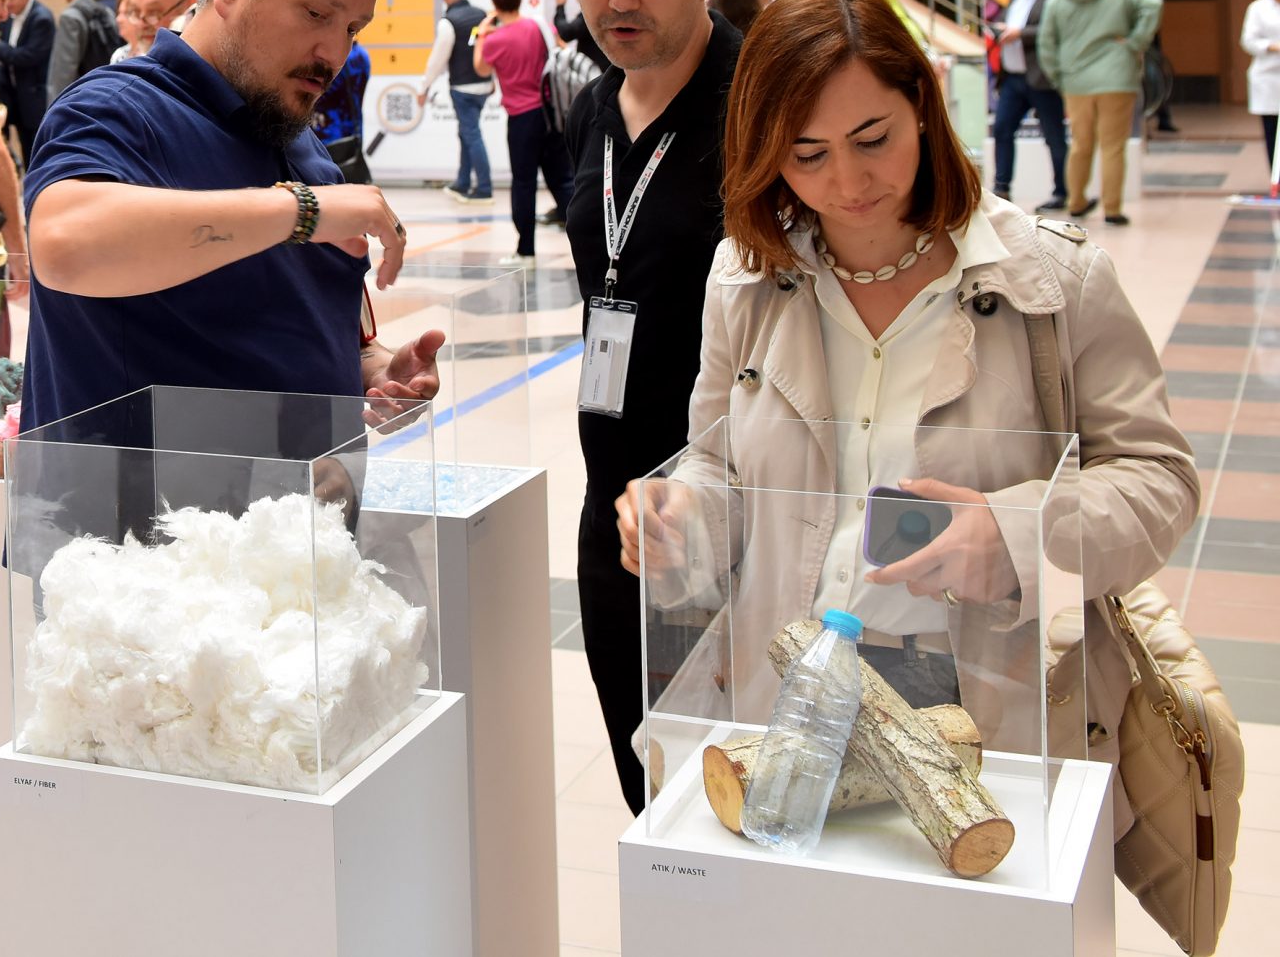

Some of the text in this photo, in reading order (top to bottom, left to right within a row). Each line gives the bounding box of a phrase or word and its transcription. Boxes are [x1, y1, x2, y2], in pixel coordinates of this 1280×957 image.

[14, 777, 32, 786] ELYAF
[651, 863, 670, 873] ATIK
[677, 867, 706, 876] WASTE
